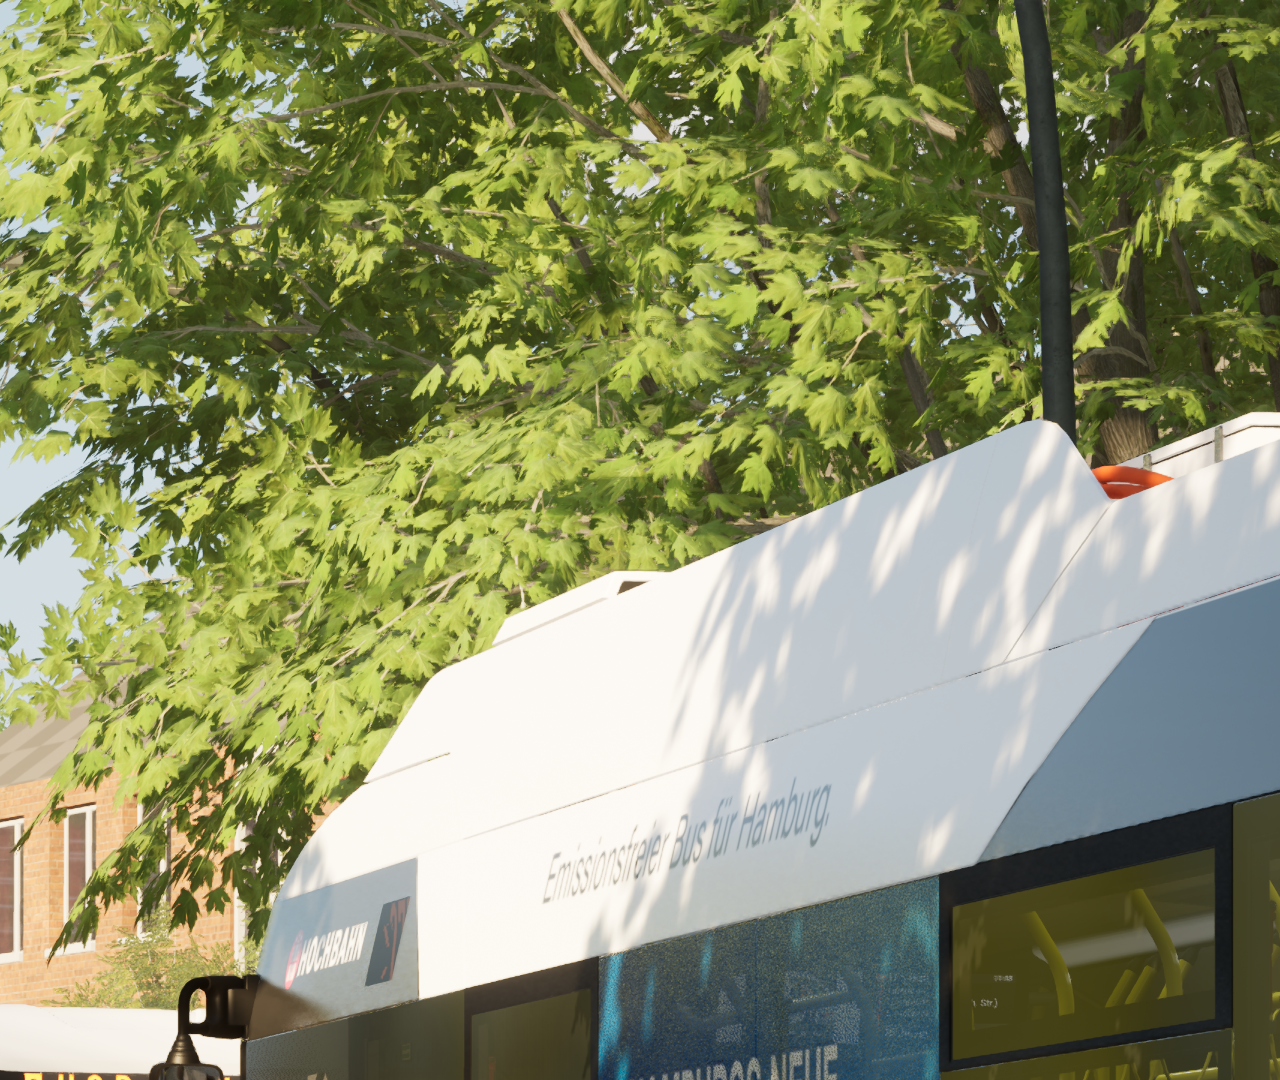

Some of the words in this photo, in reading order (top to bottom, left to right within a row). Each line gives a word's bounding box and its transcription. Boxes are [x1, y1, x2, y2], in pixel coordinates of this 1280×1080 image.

[542, 819, 670, 904] Emissionsfreier
[669, 813, 706, 870] Bus
[706, 796, 738, 860] für
[736, 776, 832, 848] Hamburg.
[296, 921, 368, 977] HOCHBAHN
